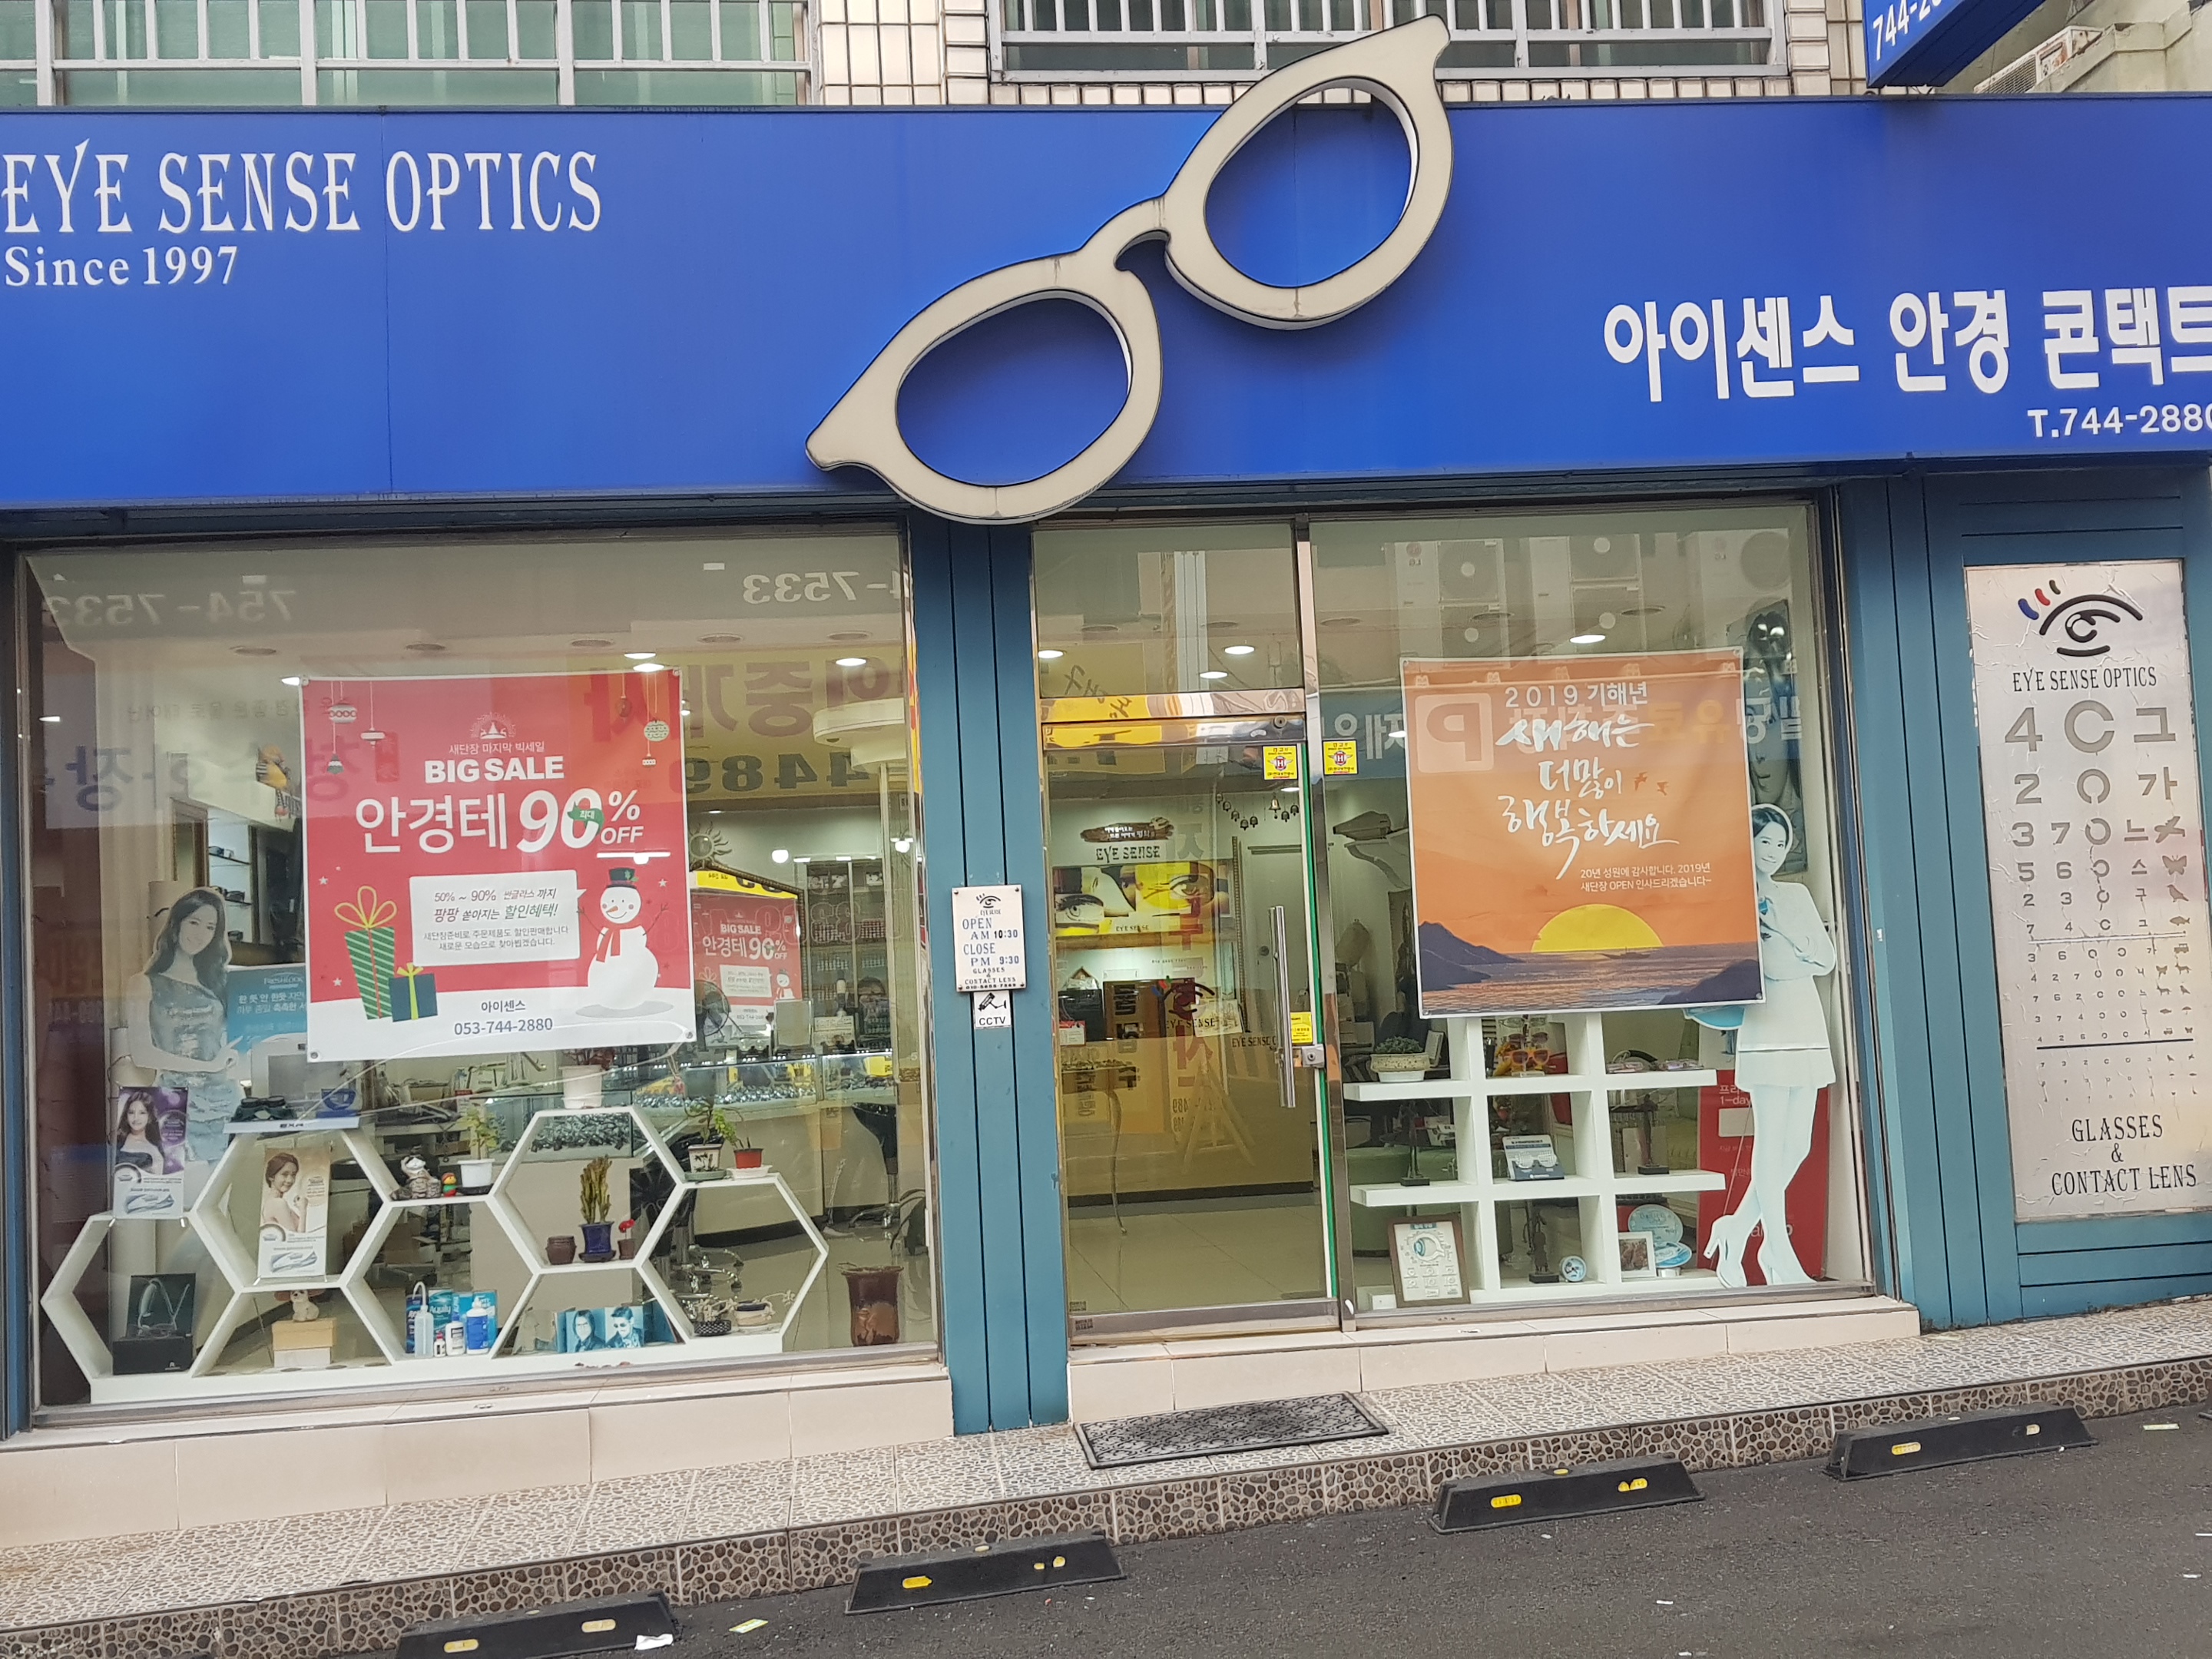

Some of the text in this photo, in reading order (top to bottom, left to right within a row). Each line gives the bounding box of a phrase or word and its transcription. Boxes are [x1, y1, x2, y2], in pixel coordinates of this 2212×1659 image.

[1873, 0, 1942, 61] 744-2
[2, 138, 602, 233] EYE SENSE OPTICS
[3, 245, 238, 286] Since 1997
[1604, 286, 2212, 403] 아이센스 안경 콘택트
[2012, 667, 2157, 692] EYE SENSE OPTICS
[1505, 681, 1648, 708] 2019 기해년
[2004, 707, 2044, 753] 4
[449, 740, 545, 755] 새단장 마지막 빅세일
[425, 756, 565, 783] BIG SALE
[2014, 773, 2042, 804] 2
[356, 792, 508, 854] 안경테
[600, 826, 644, 846] OFF
[1497, 794, 1680, 880] 행복하세요
[2012, 822, 2035, 846] 3
[2051, 822, 2071, 845] 7
[1096, 846, 1161, 863] EYE SENSE
[1580, 862, 1711, 879] 20년 성원에 감사합니다. 2019년
[2018, 862, 2035, 882] 5
[2056, 861, 2072, 879] 6
[434, 892, 455, 902] 50%
[471, 889, 496, 902] 90%
[537, 888, 557, 900] 까지
[1580, 882, 1608, 892] 새단장
[1609, 880, 1634, 891] OPEN
[2022, 893, 2035, 907] 2
[2060, 891, 2072, 906] 3
[434, 907, 459, 923] 팡팡
[505, 903, 558, 920] 할인혜택!
[962, 917, 992, 929] OPEN
[720, 923, 762, 935] BIG SALE
[971, 929, 1018, 940] AM 10:30
[464, 940, 496, 950] 모습으로
[702, 935, 747, 958] 안경테
[963, 942, 996, 955] CLOSE
[971, 955, 1019, 966] PM 9:30
[481, 1000, 526, 1014] 아이센스
[454, 1018, 553, 1036] 053-744-2880
[979, 1016, 1006, 1026] CCTV
[2071, 1114, 2164, 1143] GLASSES
[2111, 1143, 2124, 1163] &
[2051, 1164, 2197, 1197] CONTACT LENS
